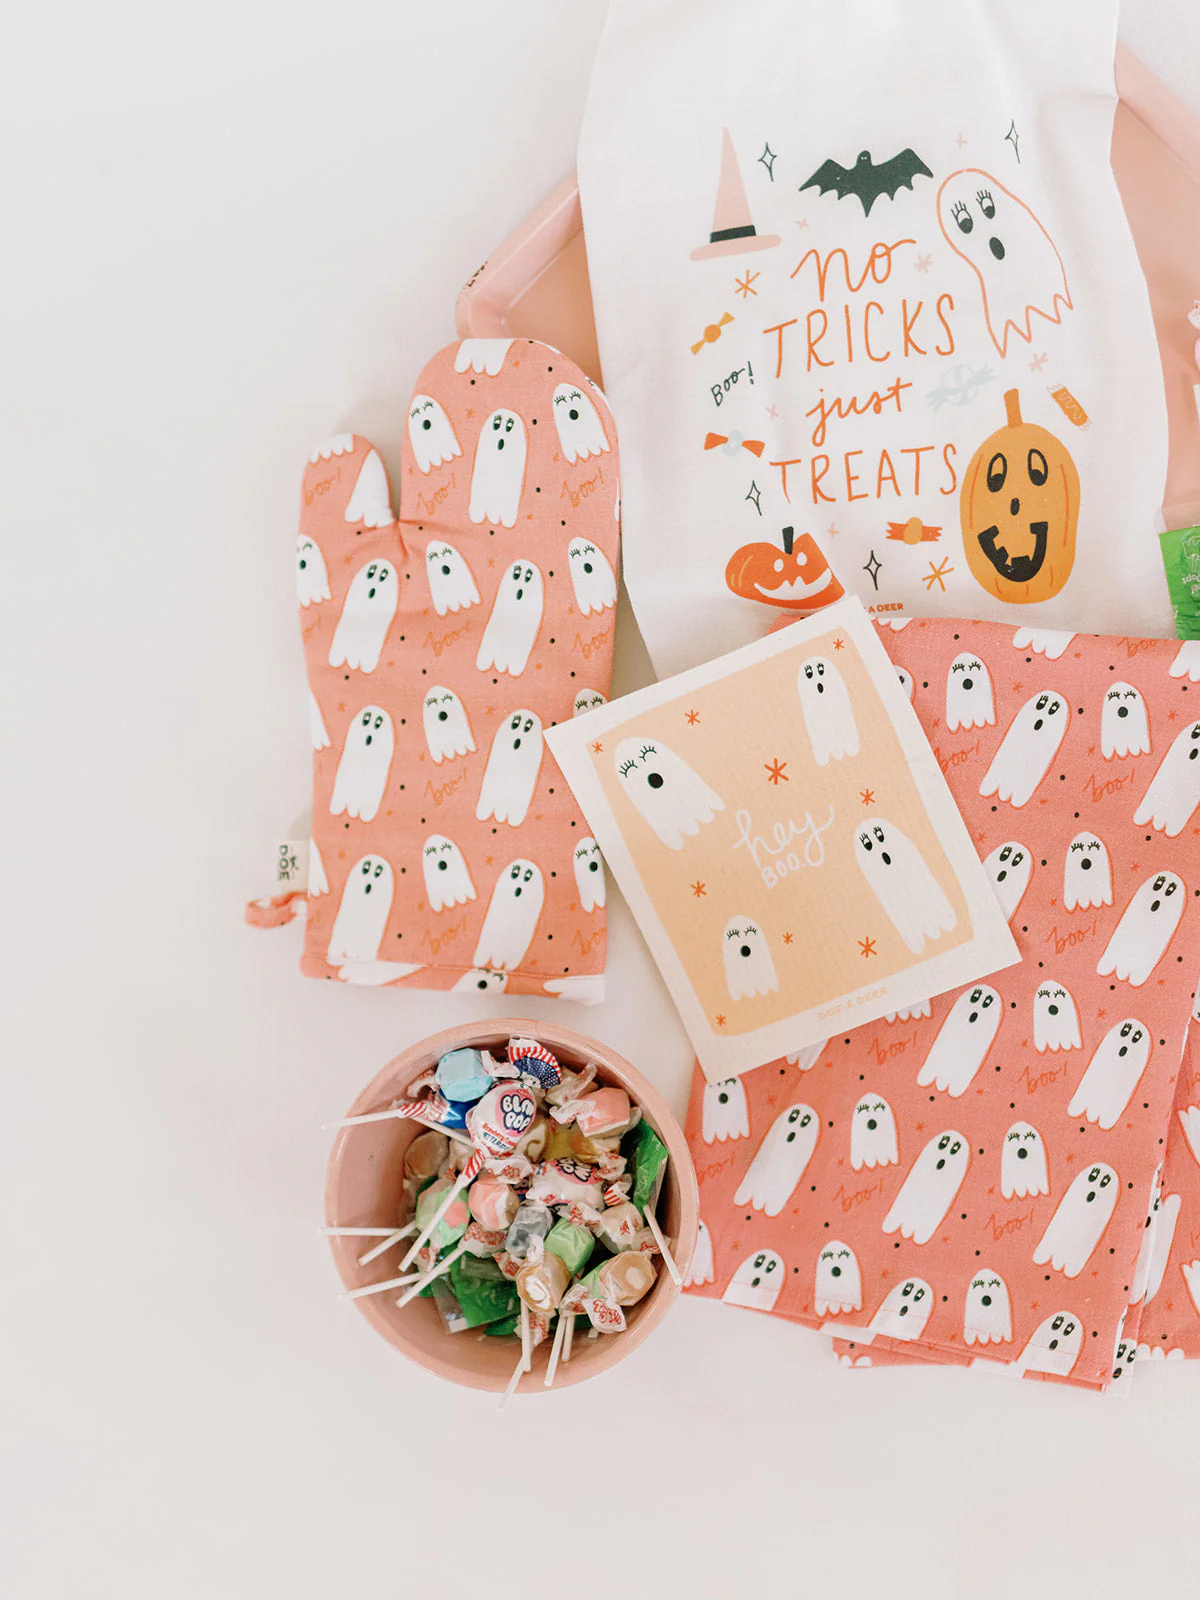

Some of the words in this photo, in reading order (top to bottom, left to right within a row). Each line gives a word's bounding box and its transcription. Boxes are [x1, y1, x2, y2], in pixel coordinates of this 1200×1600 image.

[790, 238, 917, 303] no
[762, 293, 955, 379] TRICKS
[711, 360, 755, 407] Boo!
[805, 377, 913, 448] just
[560, 466, 604, 509] boo!
[769, 443, 957, 505] TREATS
[416, 472, 457, 516] boo!
[868, 605, 876, 614] A
[876, 603, 904, 613] DEER
[422, 618, 470, 658] boo!
[573, 625, 612, 660] boo
[1117, 636, 1160, 658] boo
[424, 768, 467, 807] boo!
[1082, 767, 1135, 803] boo!
[732, 804, 835, 870] hey
[278, 844, 291, 881] DOE
[421, 914, 467, 955] boo!
[1045, 919, 1098, 955] boo!
[818, 1003, 843, 1020] DOE
[846, 998, 854, 1009] A
[856, 986, 888, 1005] DEER
[868, 1031, 917, 1066] boo!
[1015, 1060, 1068, 1094] boo!
[503, 1110, 532, 1133] POP
[831, 1177, 884, 1213] boo!
[982, 1207, 1035, 1241] boo!
